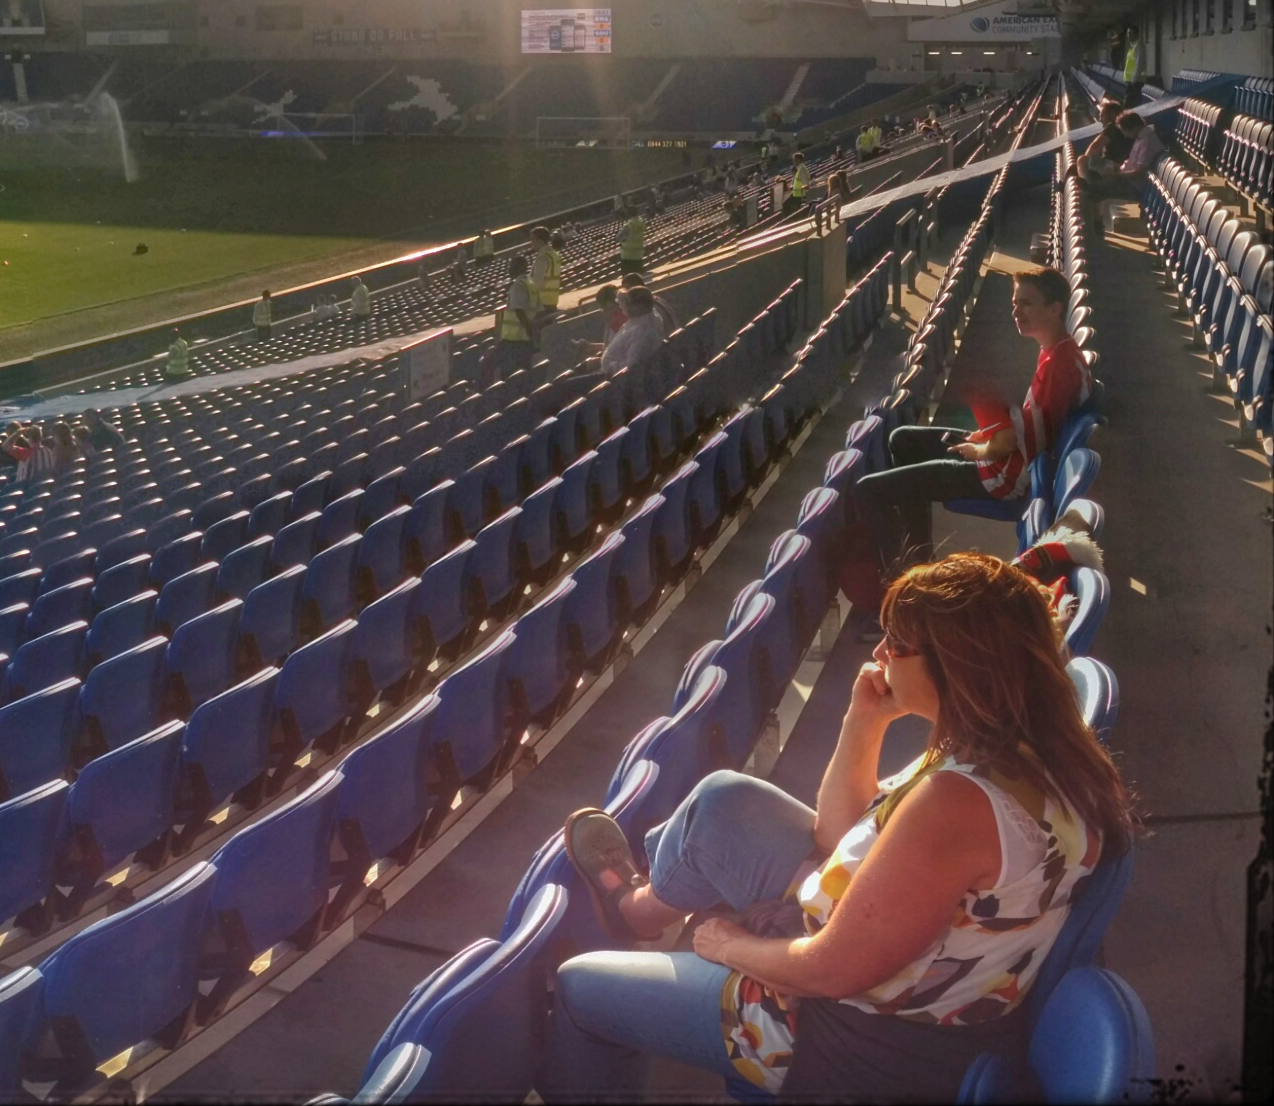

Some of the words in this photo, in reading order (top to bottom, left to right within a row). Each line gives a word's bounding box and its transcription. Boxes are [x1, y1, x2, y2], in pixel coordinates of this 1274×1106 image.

[992, 26, 1038, 34] COMMUNITY
[331, 30, 365, 42] STAND
[370, 30, 384, 41] OR
[389, 30, 415, 42] FALL
